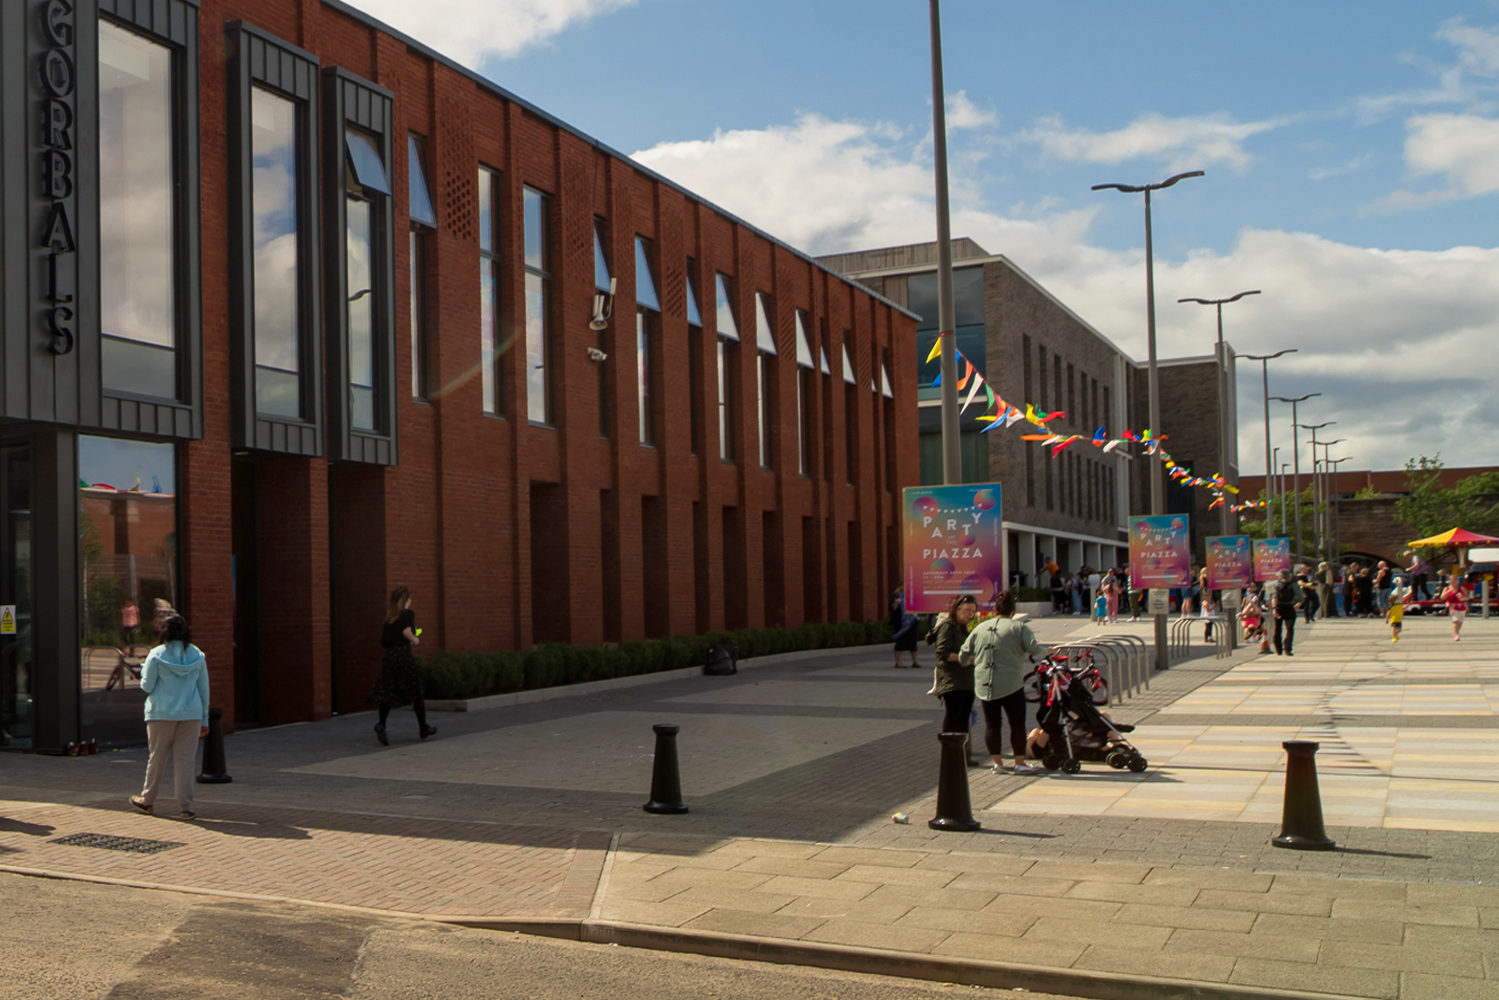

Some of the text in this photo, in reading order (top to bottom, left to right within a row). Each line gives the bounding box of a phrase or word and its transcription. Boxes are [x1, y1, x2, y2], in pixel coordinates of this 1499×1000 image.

[923, 512, 982, 538] PARTY
[1140, 531, 1177, 546] PARTY
[923, 548, 983, 559] PIAZZA
